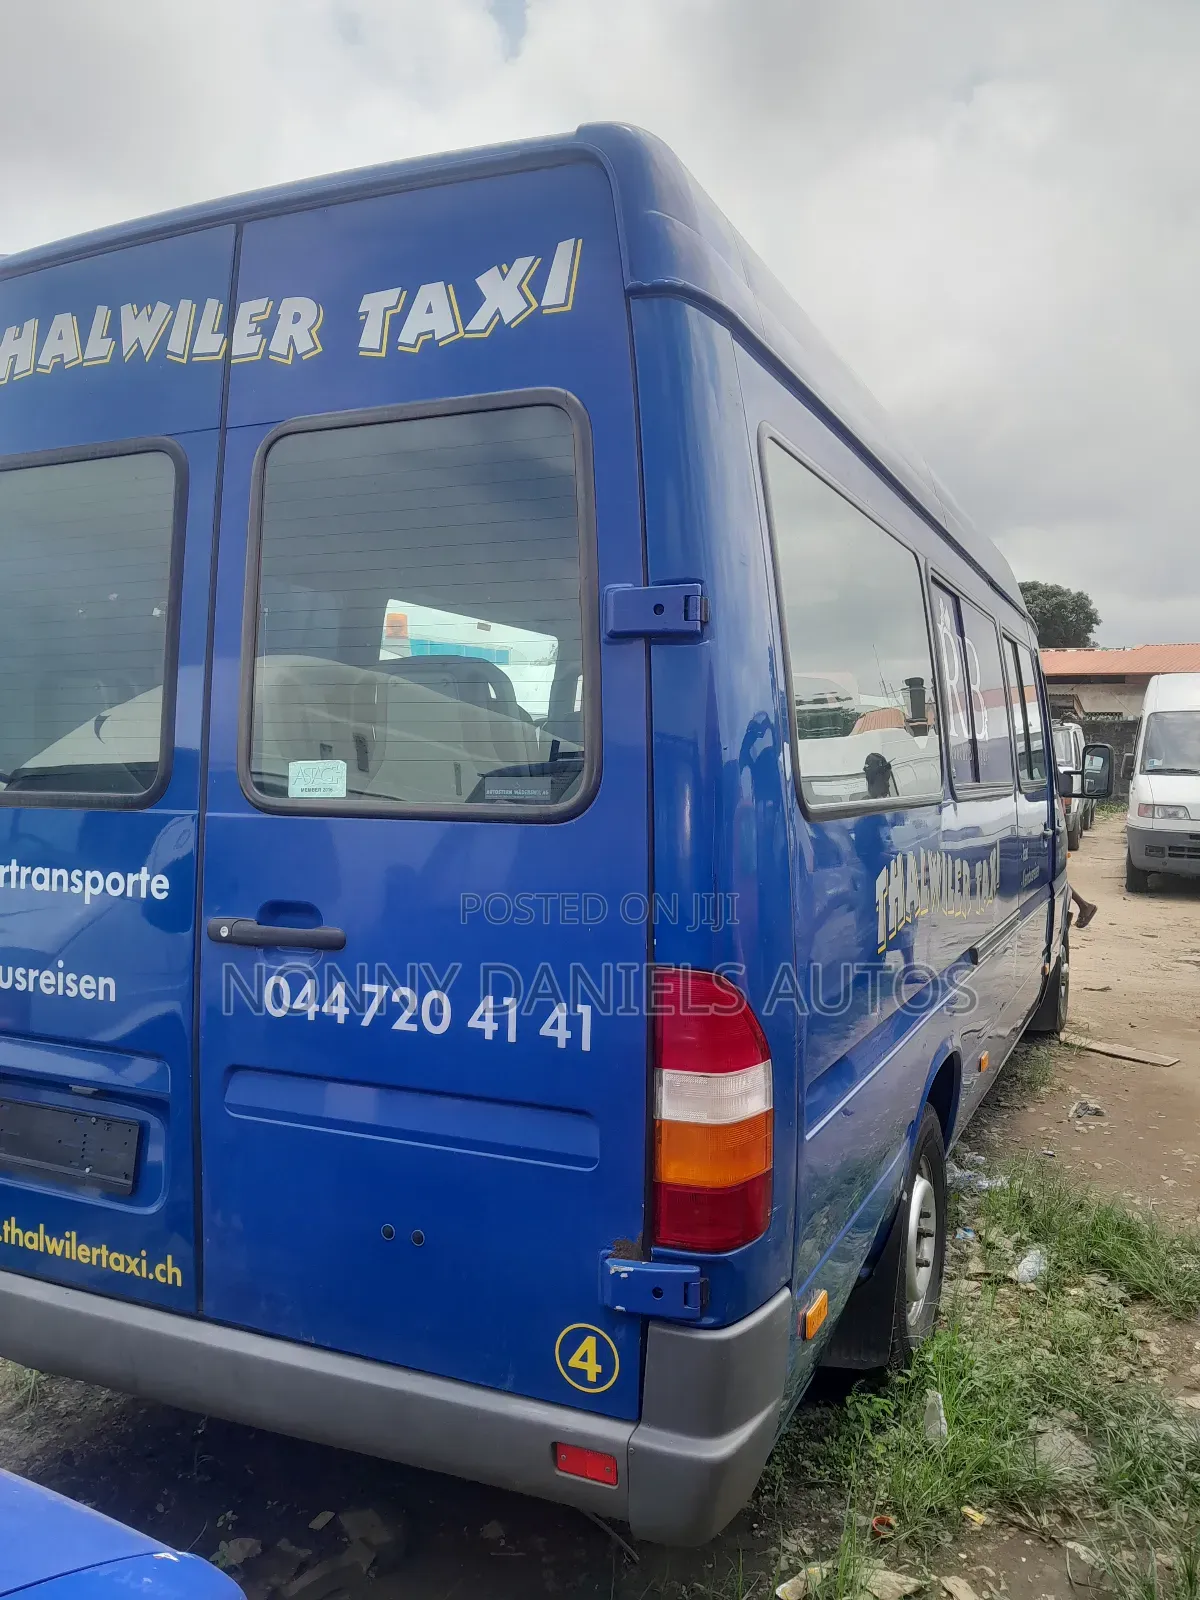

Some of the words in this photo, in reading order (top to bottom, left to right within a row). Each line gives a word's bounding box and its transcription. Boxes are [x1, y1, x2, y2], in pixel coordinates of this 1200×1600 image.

[0, 297, 323, 385] HALWILER
[358, 237, 583, 357] TAXI
[0, 858, 170, 904] rtransporte
[0, 959, 116, 1002] usreisen
[264, 975, 350, 1025] 044
[360, 983, 452, 1035] 720
[467, 995, 517, 1043] 41
[539, 1002, 592, 1052] 41
[568, 1335, 602, 1383] 4
